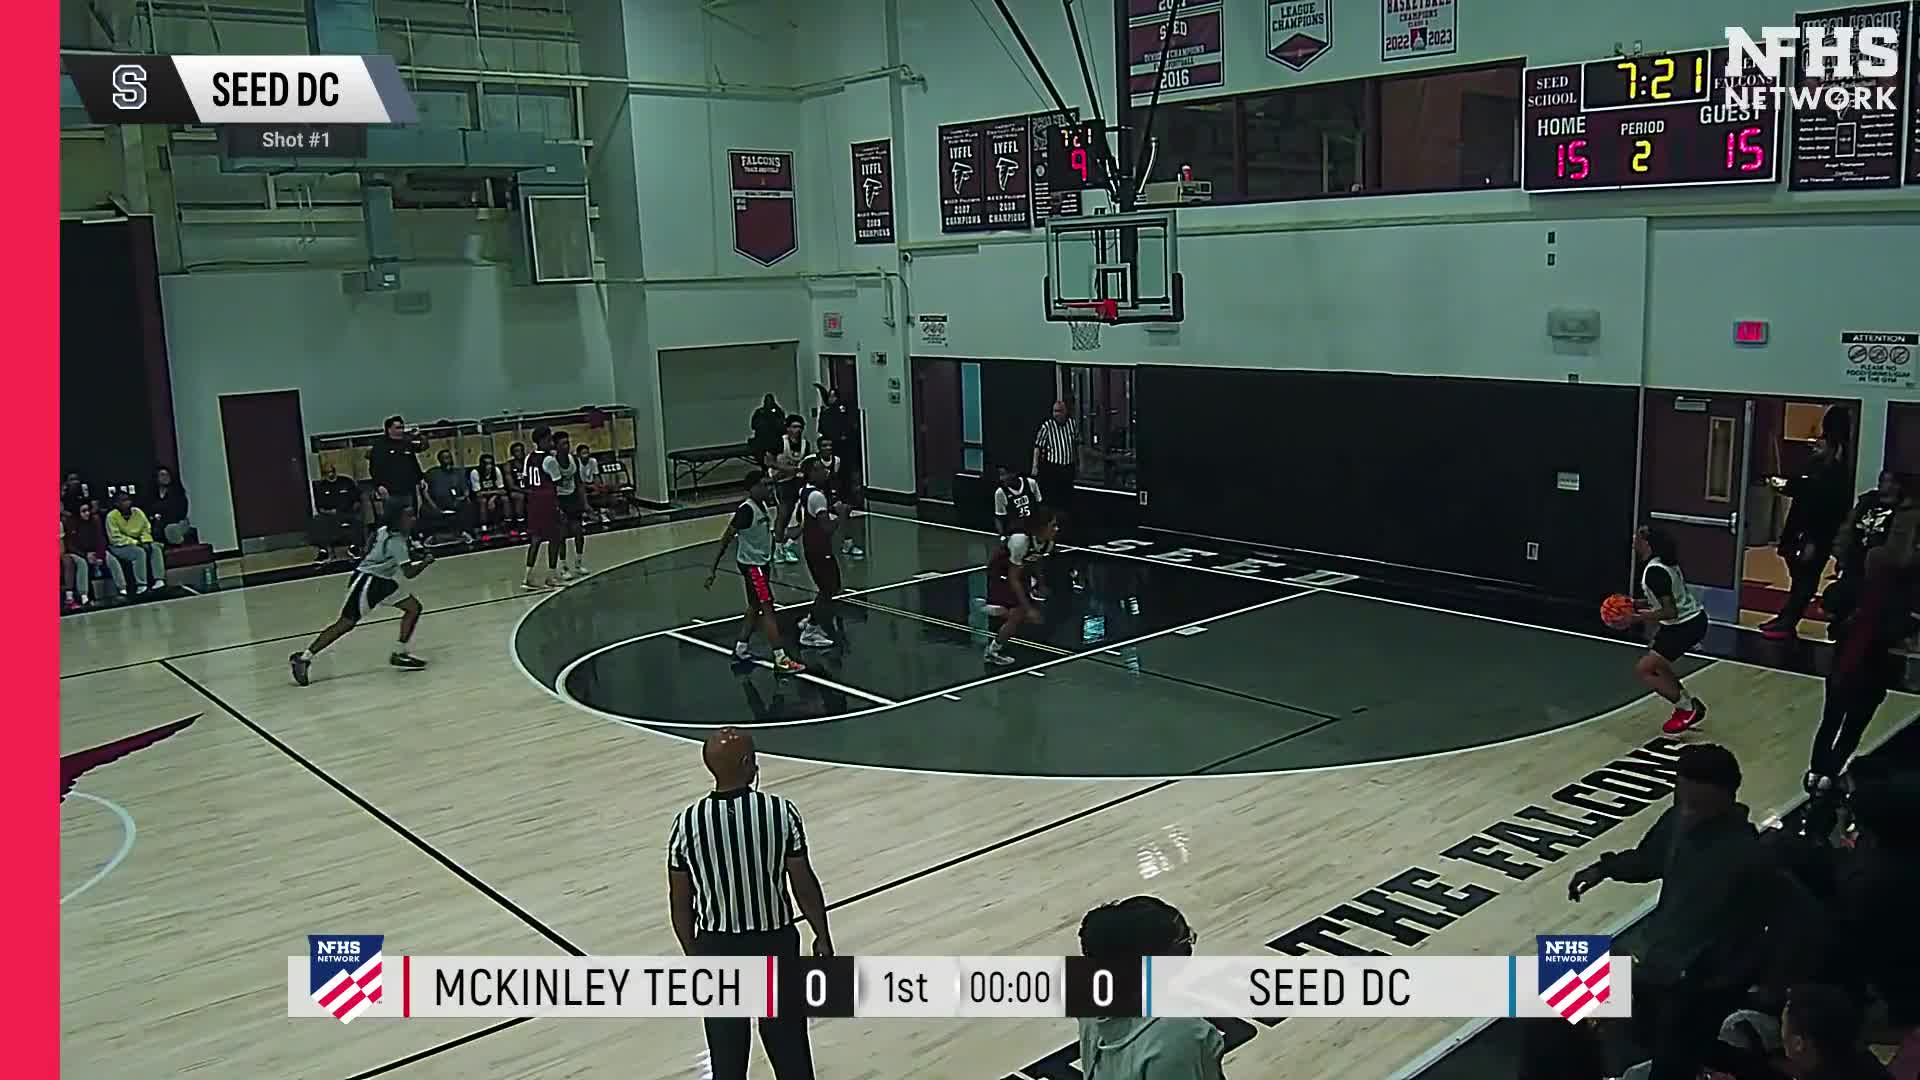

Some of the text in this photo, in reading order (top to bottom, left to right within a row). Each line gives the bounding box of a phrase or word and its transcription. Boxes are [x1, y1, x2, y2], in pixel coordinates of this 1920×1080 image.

[1280, 3, 1316, 18] LEAGUE
[1387, 0, 1452, 13] BASKET
[1160, 21, 1188, 40] SED
[1273, 14, 1325, 32] CHAMPIONS
[1386, 29, 1452, 51] 2022 2023
[1160, 69, 1189, 89] 2016
[1536, 75, 1569, 90] SEED
[1618, 58, 1702, 99] 7:21
[1527, 92, 1577, 107] SCHOOL
[1700, 102, 1761, 124] GUEST
[1537, 116, 1587, 136] HOME
[1620, 120, 1665, 135] PERIOD
[1632, 140, 1651, 171] 2
[1726, 128, 1764, 171] 15
[741, 156, 781, 168] FALCONS
[1071, 149, 1087, 181] 9
[1557, 140, 1589, 180] 15
[1853, 334, 1905, 343] ATTENTION
[529, 466, 541, 486] 10
[1088, 539, 1361, 586] SEED
[1264, 865, 1501, 957] THE
